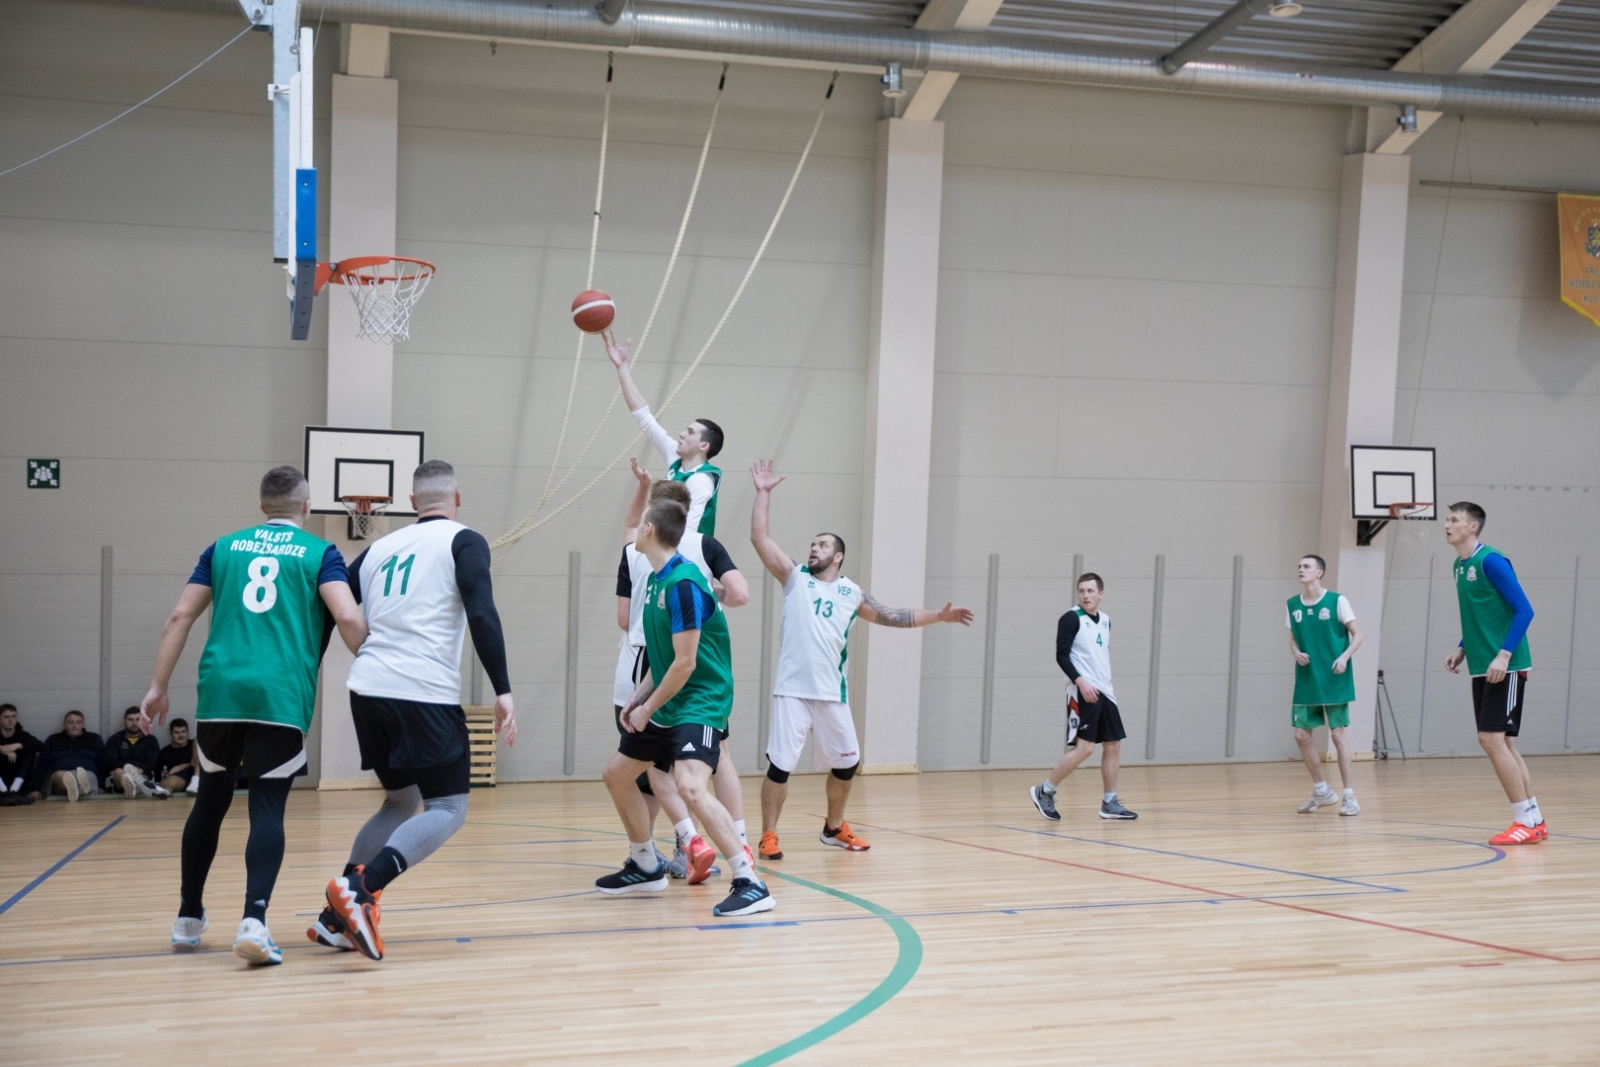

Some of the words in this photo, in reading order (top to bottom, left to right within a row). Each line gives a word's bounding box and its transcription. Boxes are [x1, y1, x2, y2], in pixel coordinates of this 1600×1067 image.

[254, 529, 295, 543] VALSTS
[230, 539, 307, 558] ROBEŽSARDZE
[242, 556, 280, 613] 8
[380, 553, 416, 597] 11
[837, 585, 852, 596] VEP
[813, 597, 834, 618] 13
[1096, 632, 1103, 647] 4
